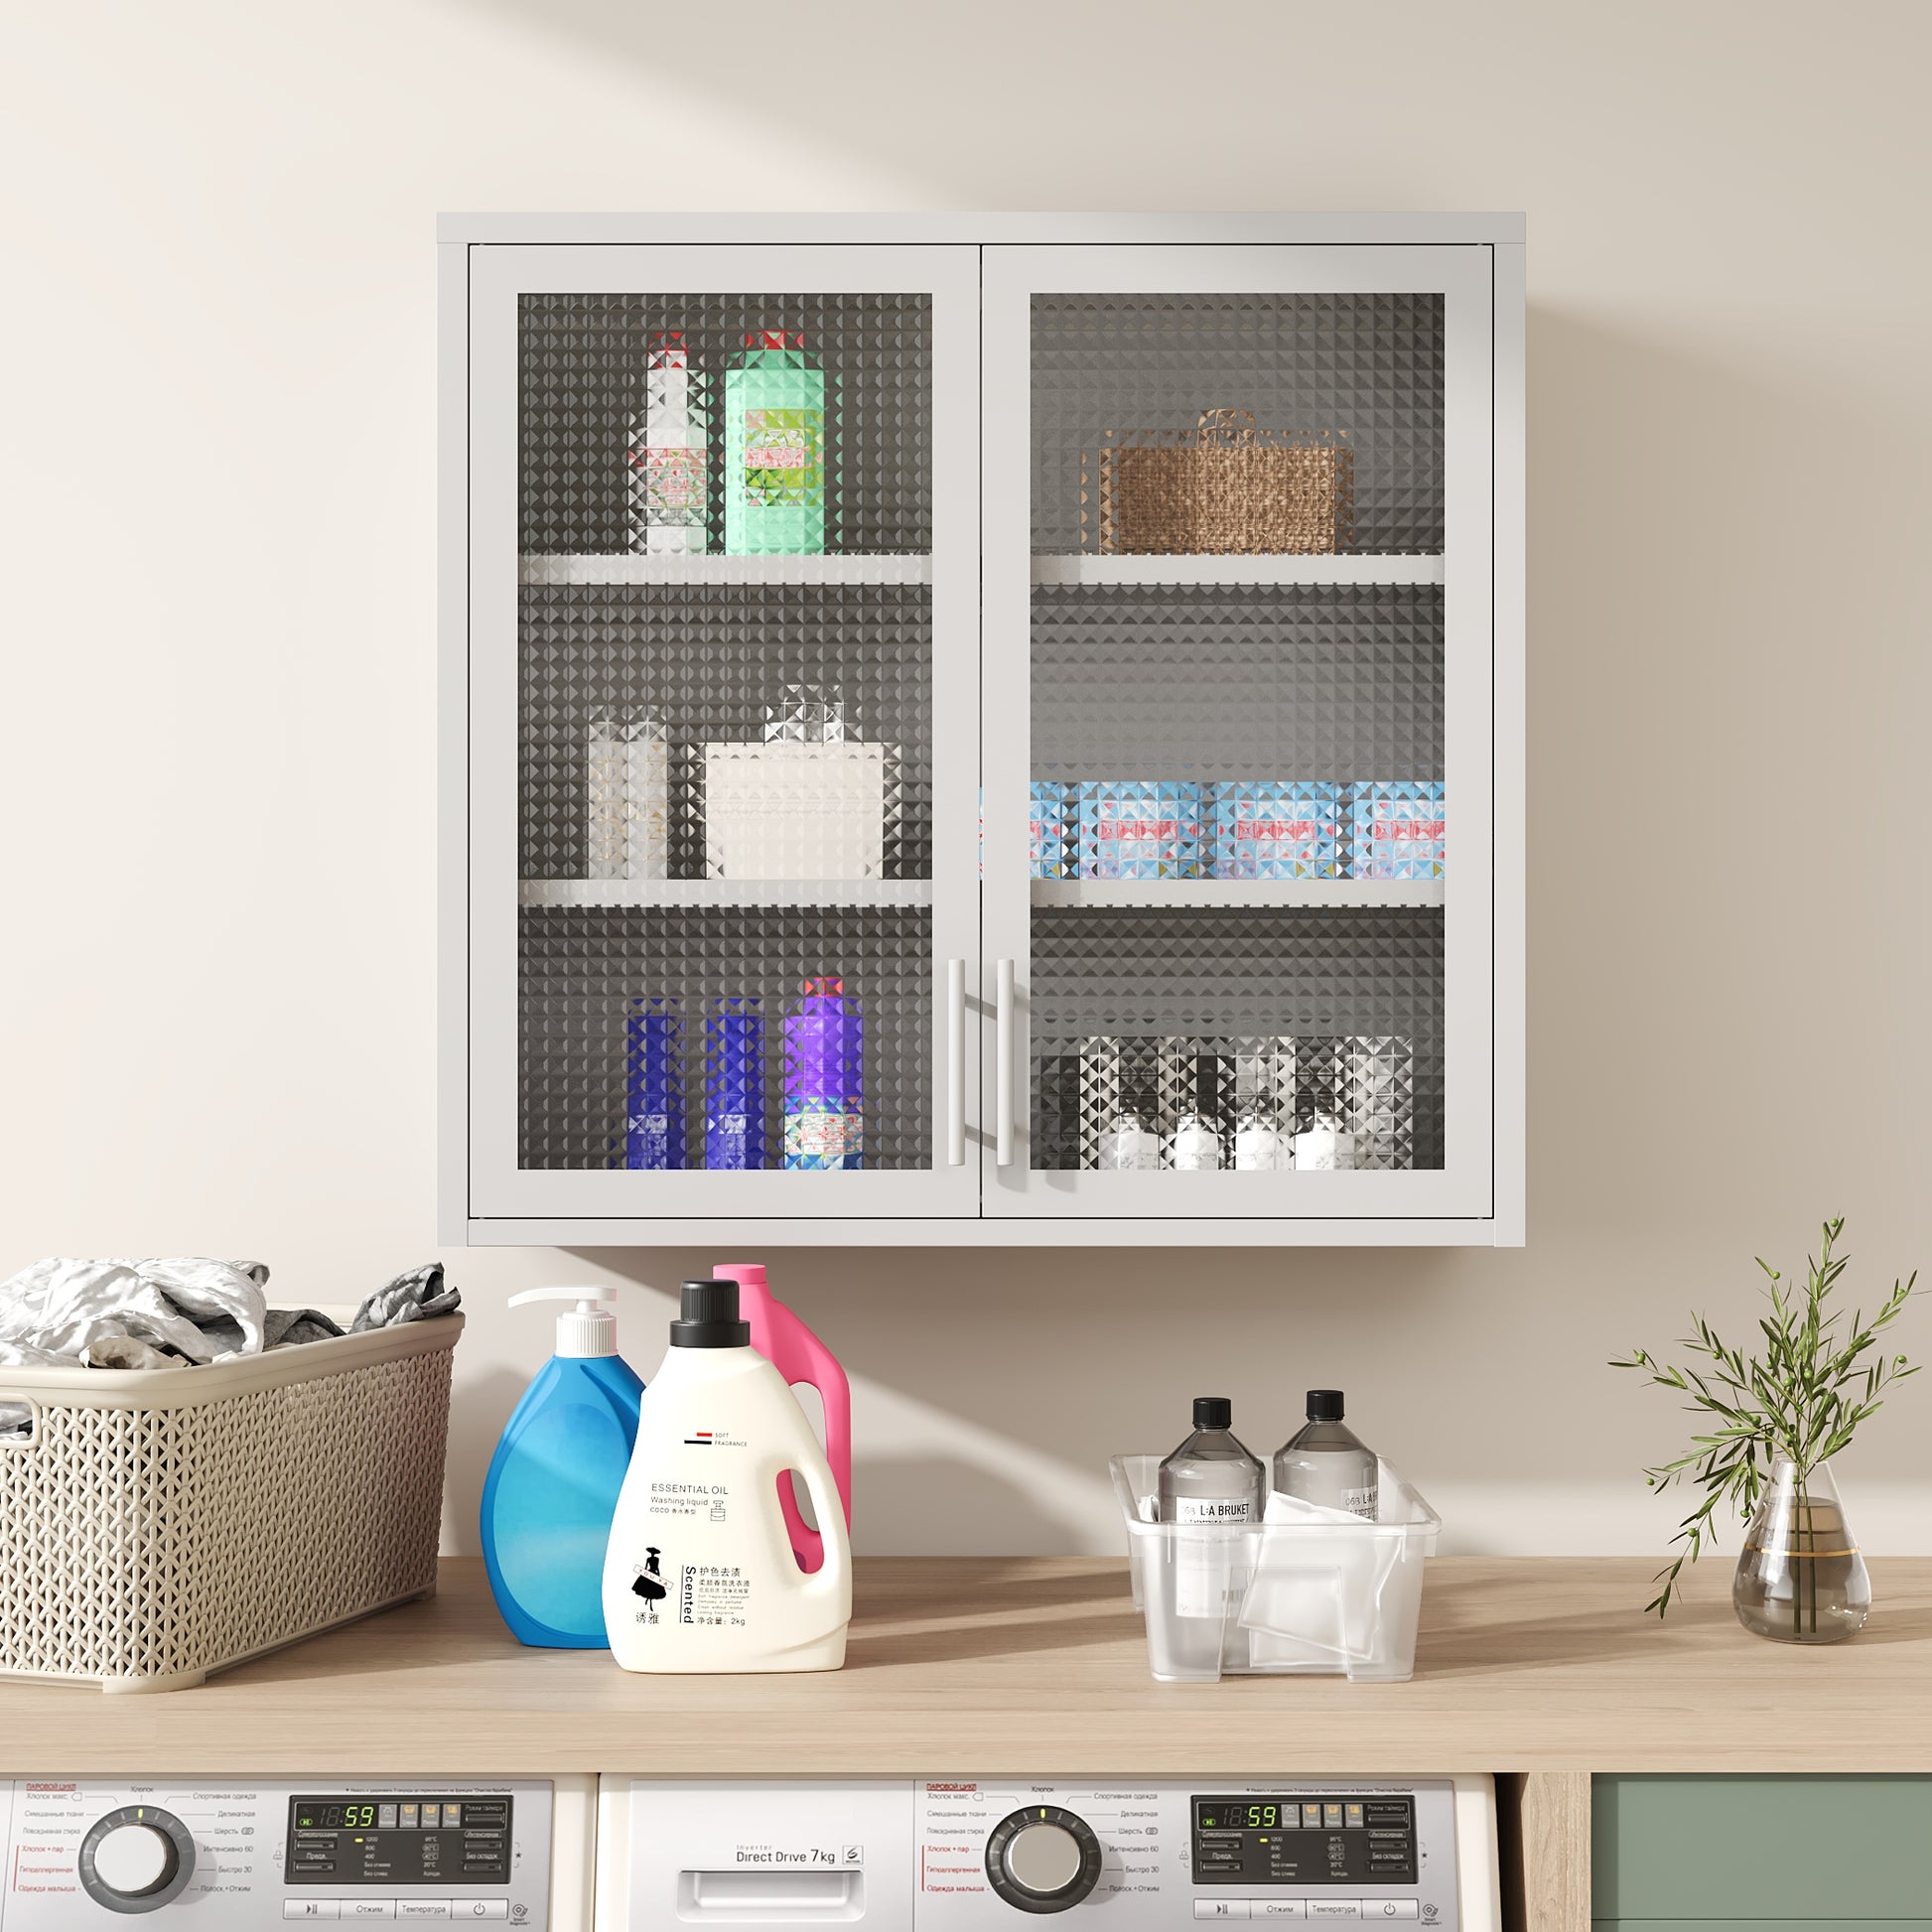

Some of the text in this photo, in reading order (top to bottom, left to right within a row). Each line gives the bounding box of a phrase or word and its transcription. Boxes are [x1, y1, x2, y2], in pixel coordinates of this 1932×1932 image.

[651, 1483, 729, 1495] ESSENTIAL OIL
[650, 1496, 685, 1507] Washing
[1200, 1504, 1215, 1516] L:A
[1218, 1503, 1250, 1516] BRUKET
[699, 1567, 741, 1578] 护色去渍
[684, 1567, 697, 1624] Scented
[635, 1611, 660, 1624] 诱雅
[731, 1617, 746, 1627] 2kg
[737, 1852, 772, 1863] Direct
[775, 1852, 807, 1863] Drive
[402, 1905, 446, 1914] Температура
[1312, 1905, 1356, 1914] Температура
